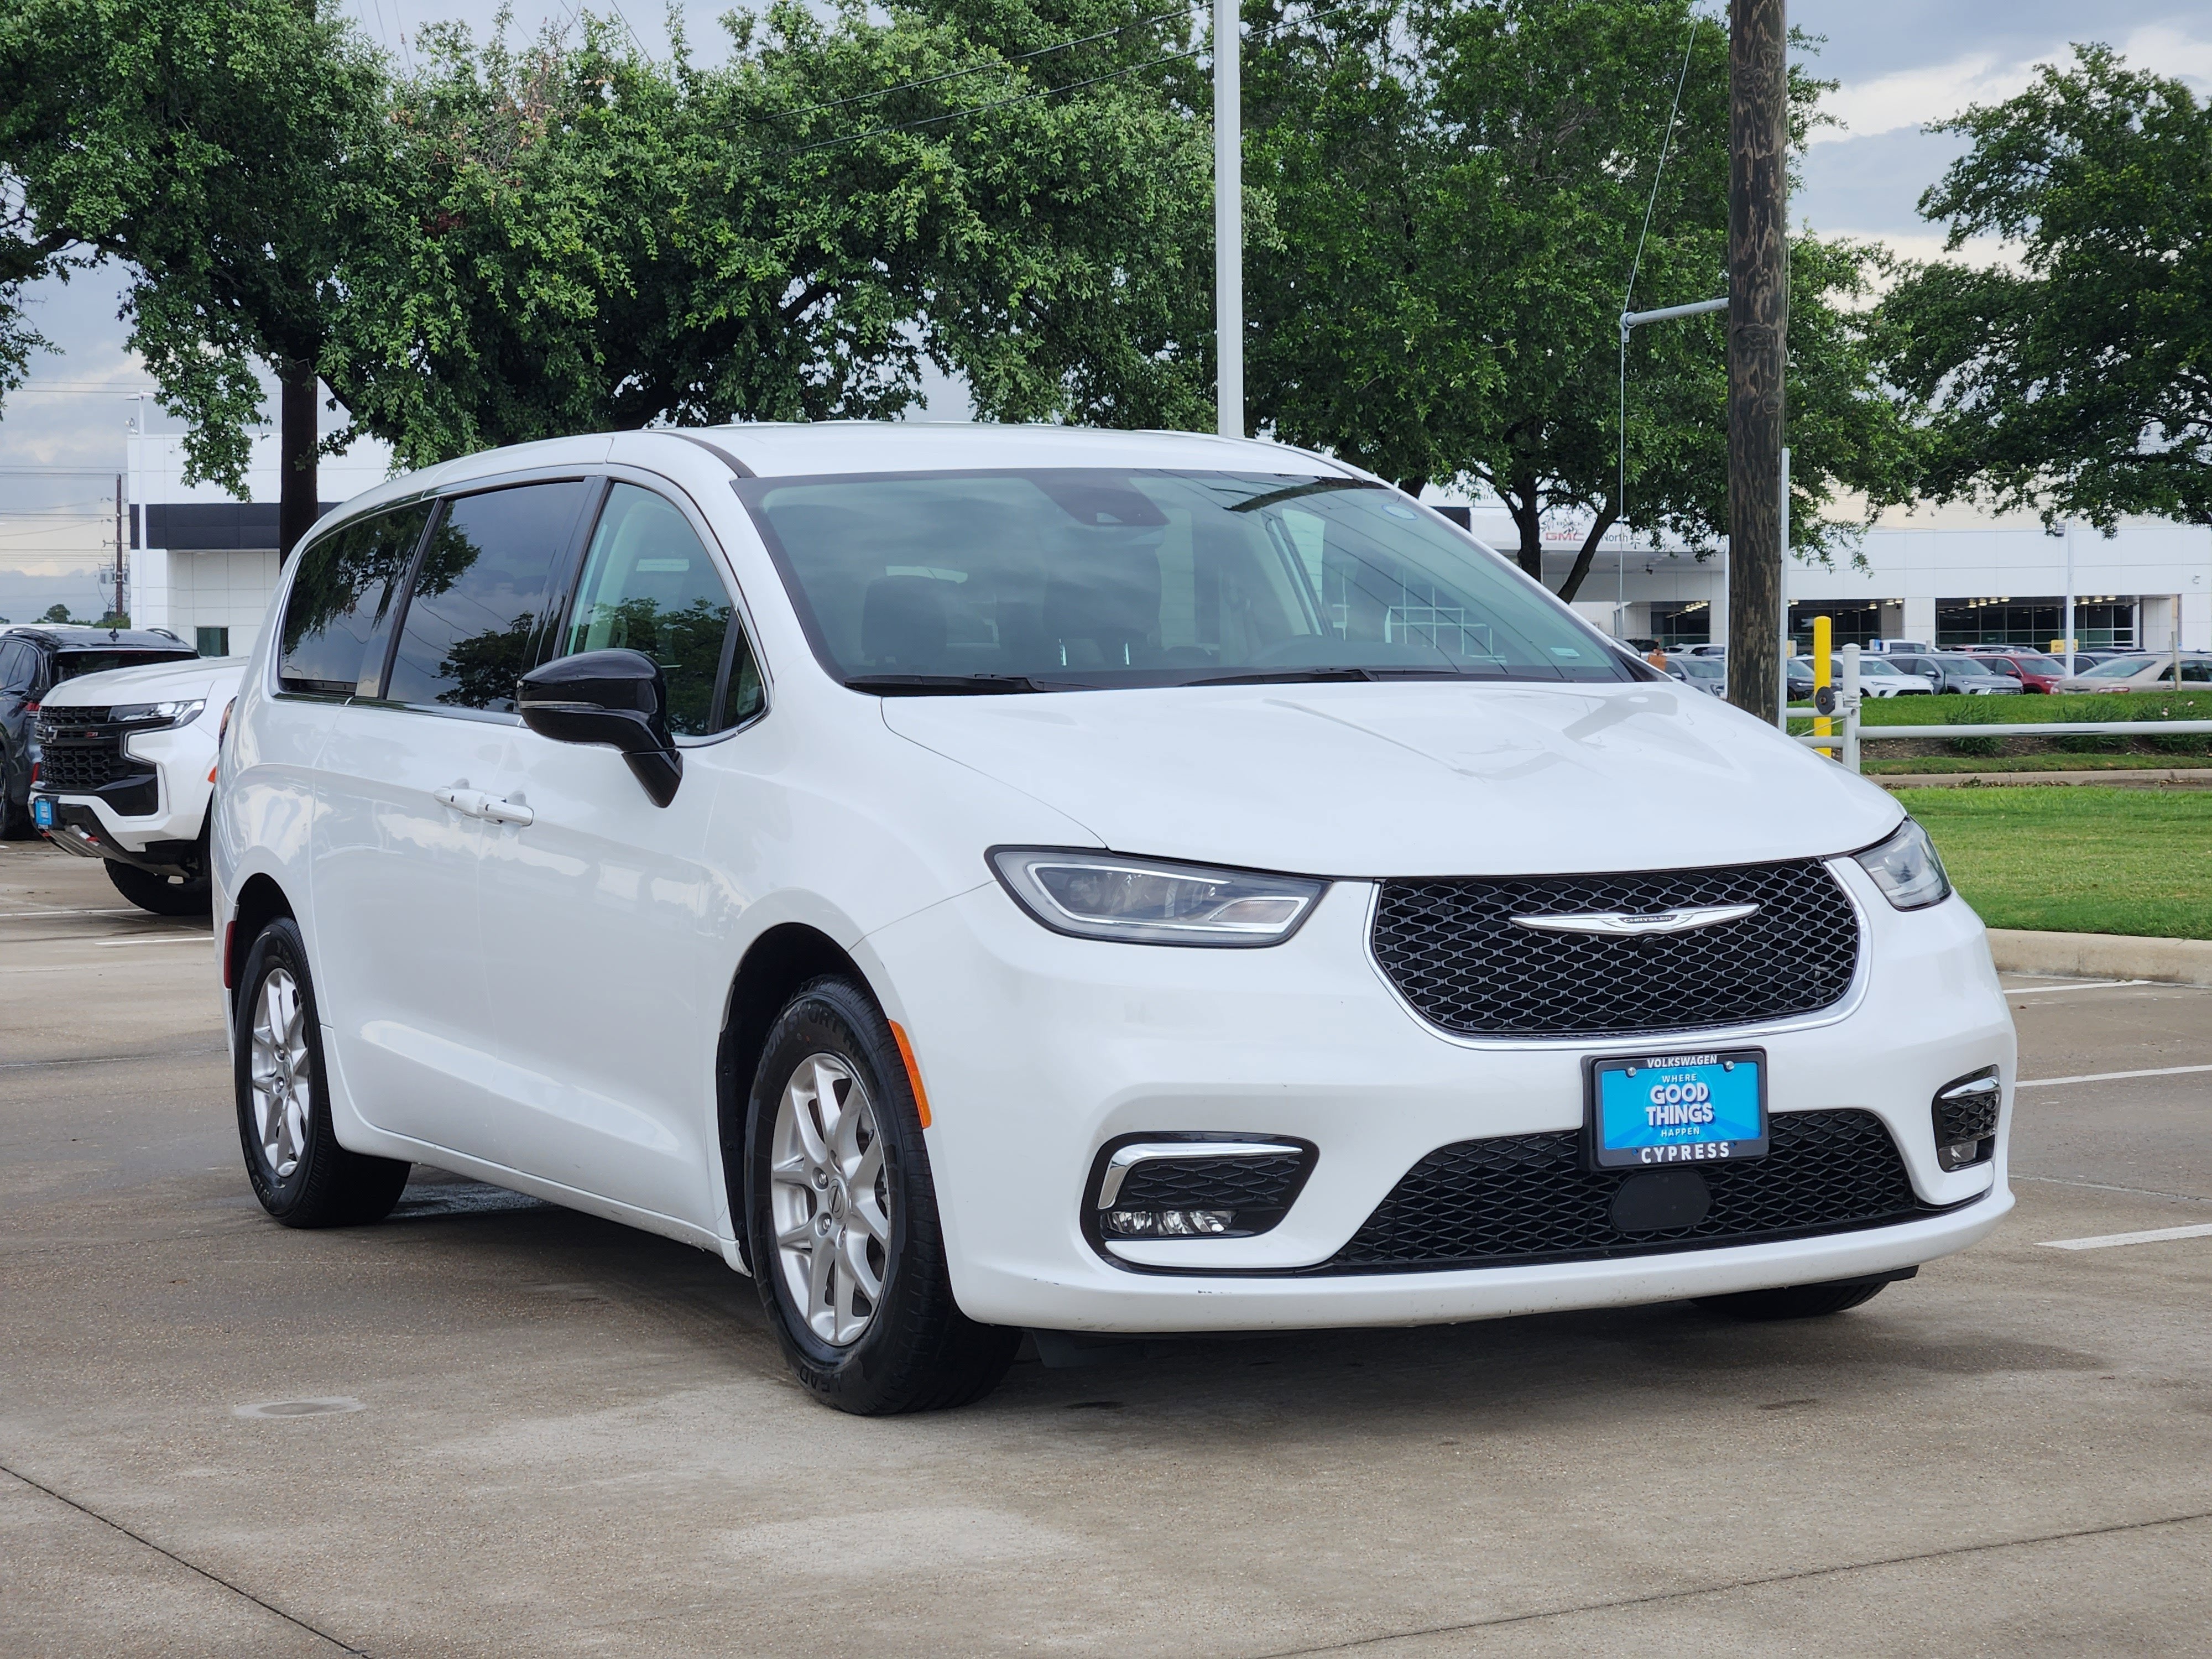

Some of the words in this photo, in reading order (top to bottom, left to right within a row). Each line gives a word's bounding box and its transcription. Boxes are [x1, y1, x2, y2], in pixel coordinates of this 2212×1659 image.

[1546, 533, 1584, 541] GMC
[1601, 532, 1628, 542] North
[1647, 1055, 1717, 1068] VOLKSWAGEN
[1662, 1073, 1697, 1083] WHERE
[1650, 1082, 1708, 1104] GOOD
[1646, 1102, 1713, 1126] THINGS
[1661, 1127, 1700, 1138] HAPPEN
[1641, 1142, 1729, 1164] CYPRESS
